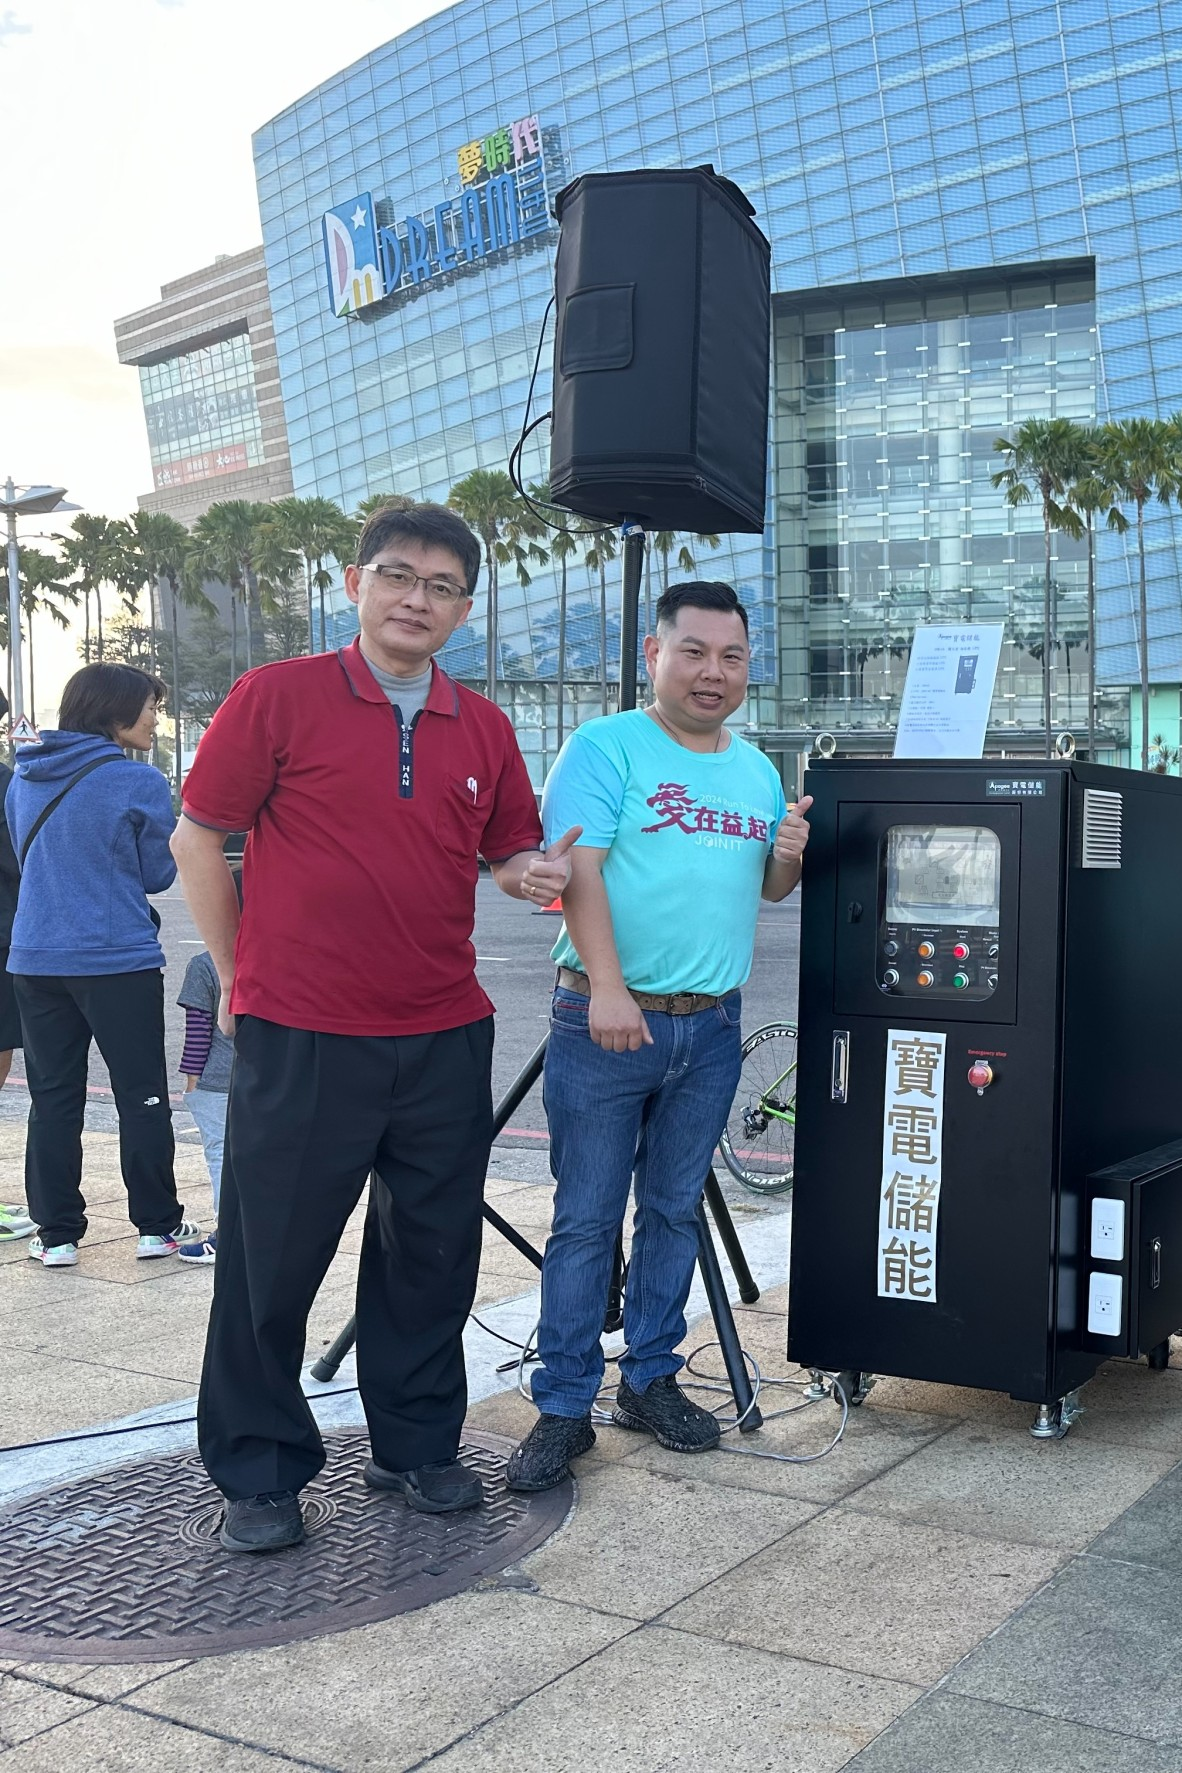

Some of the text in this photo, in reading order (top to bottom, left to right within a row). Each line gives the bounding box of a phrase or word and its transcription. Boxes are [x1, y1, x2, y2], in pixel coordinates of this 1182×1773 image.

[457, 115, 538, 184] 夢時代
[518, 156, 549, 237] MALL
[380, 173, 519, 294] DREAM
[402, 765, 410, 786] HAN
[700, 794, 722, 804] 2024
[723, 799, 739, 809] Run
[731, 839, 744, 852] IT
[882, 1037, 942, 1298] 寶電儲能
